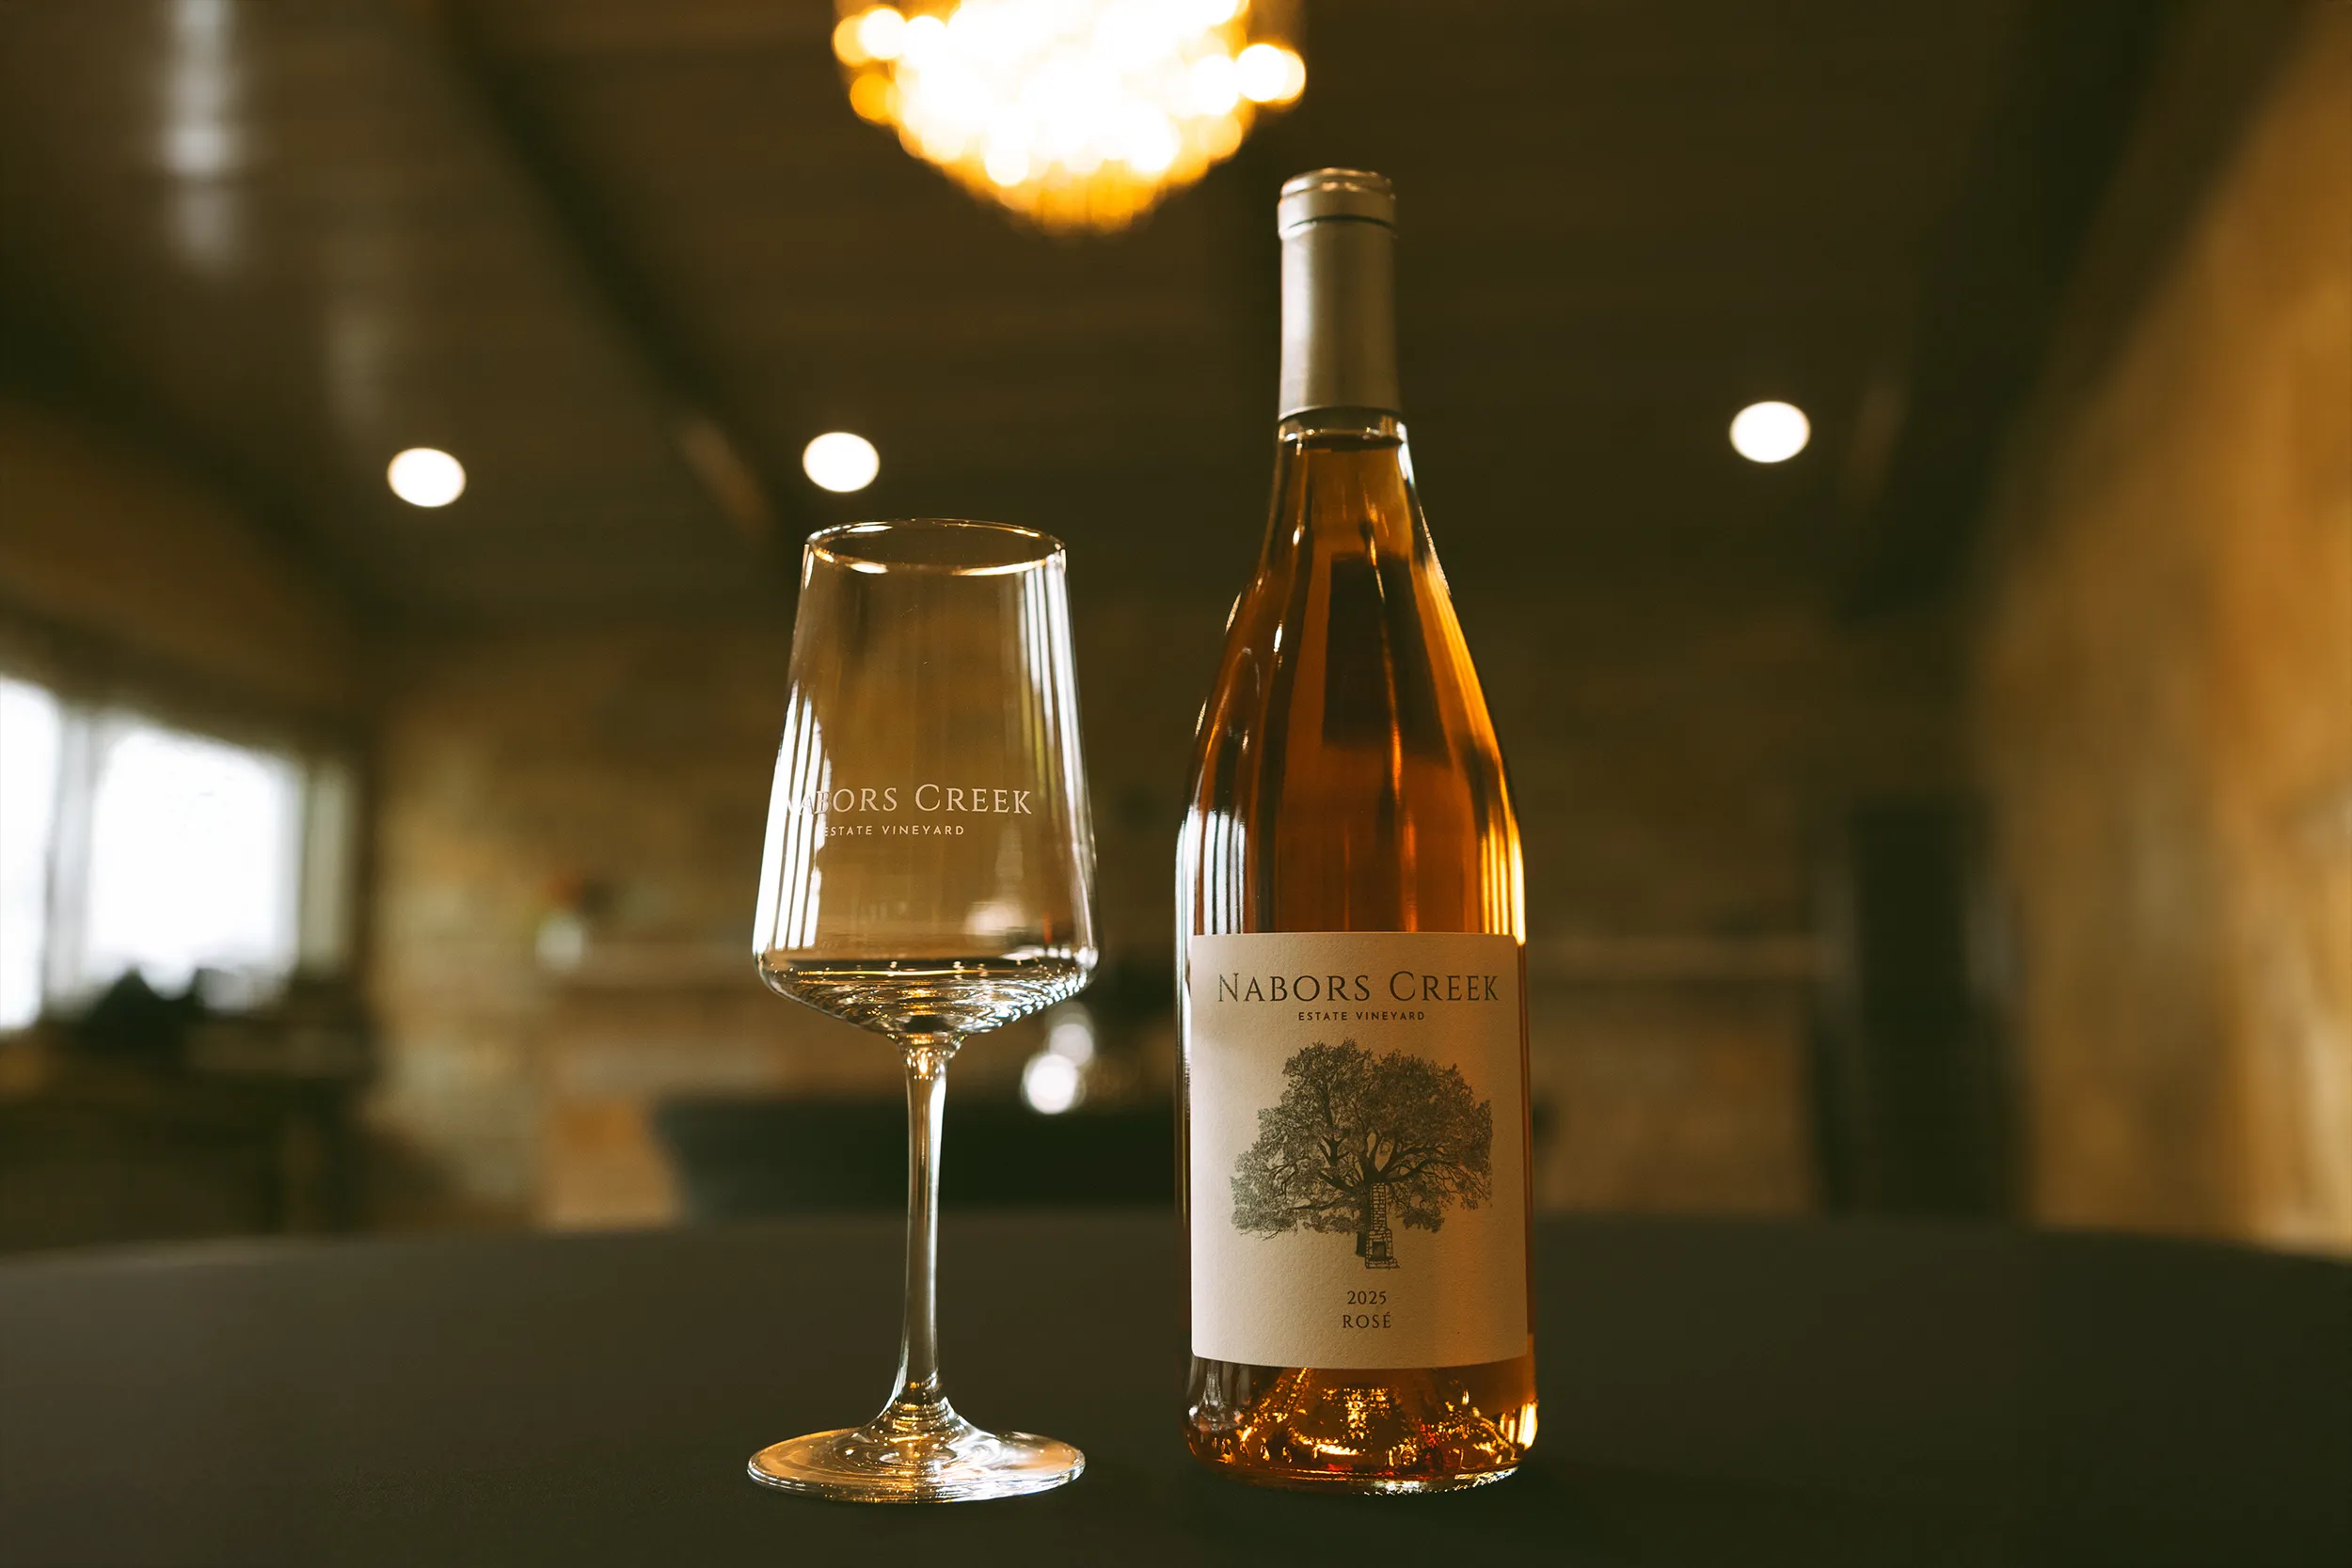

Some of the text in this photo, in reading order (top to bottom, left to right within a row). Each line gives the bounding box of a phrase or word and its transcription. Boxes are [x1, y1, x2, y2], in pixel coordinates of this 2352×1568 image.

[787, 787, 898, 815] ABORS
[882, 824, 965, 835] VINEYARD
[1217, 971, 1499, 1003] NABORS CREEK
[1297, 1010, 1426, 1022] ESTATE VINEYARD
[1346, 1290, 1387, 1306] 2025
[1342, 1311, 1392, 1329] ROSÉ
